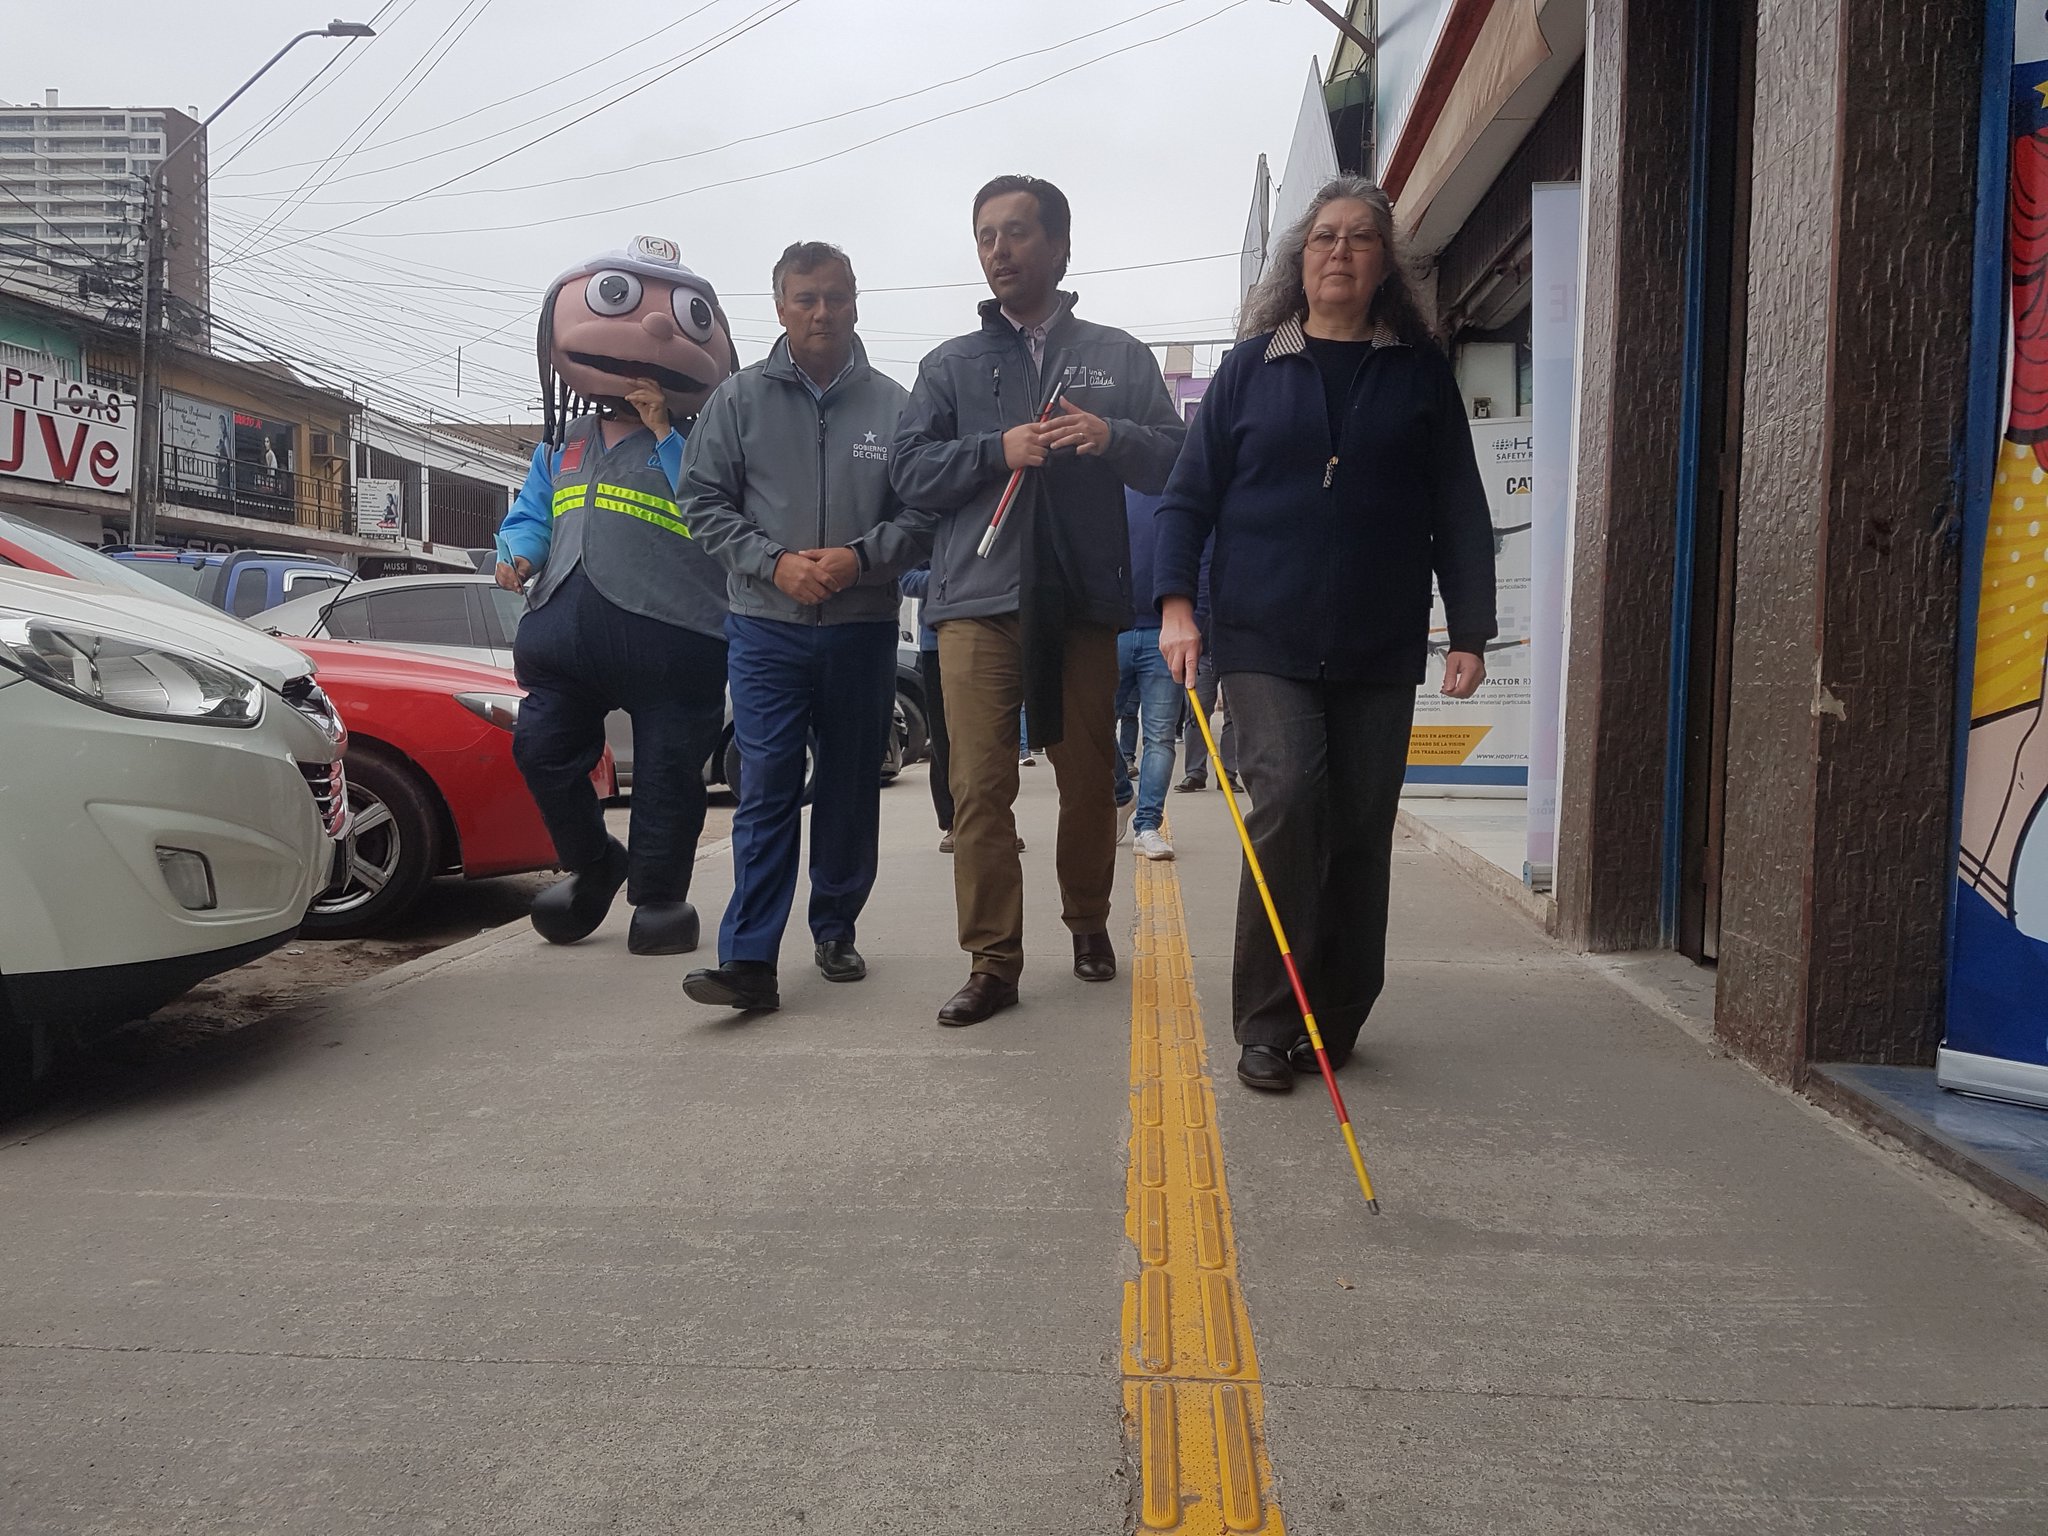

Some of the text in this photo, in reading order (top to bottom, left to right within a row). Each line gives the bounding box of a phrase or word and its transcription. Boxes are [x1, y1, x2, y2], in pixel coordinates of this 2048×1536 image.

[0, 367, 121, 423] PTICAS
[853, 443, 888, 453] GOBIERNO
[852, 450, 888, 461] DE CHILE
[1496, 451, 1526, 461] SAFETY
